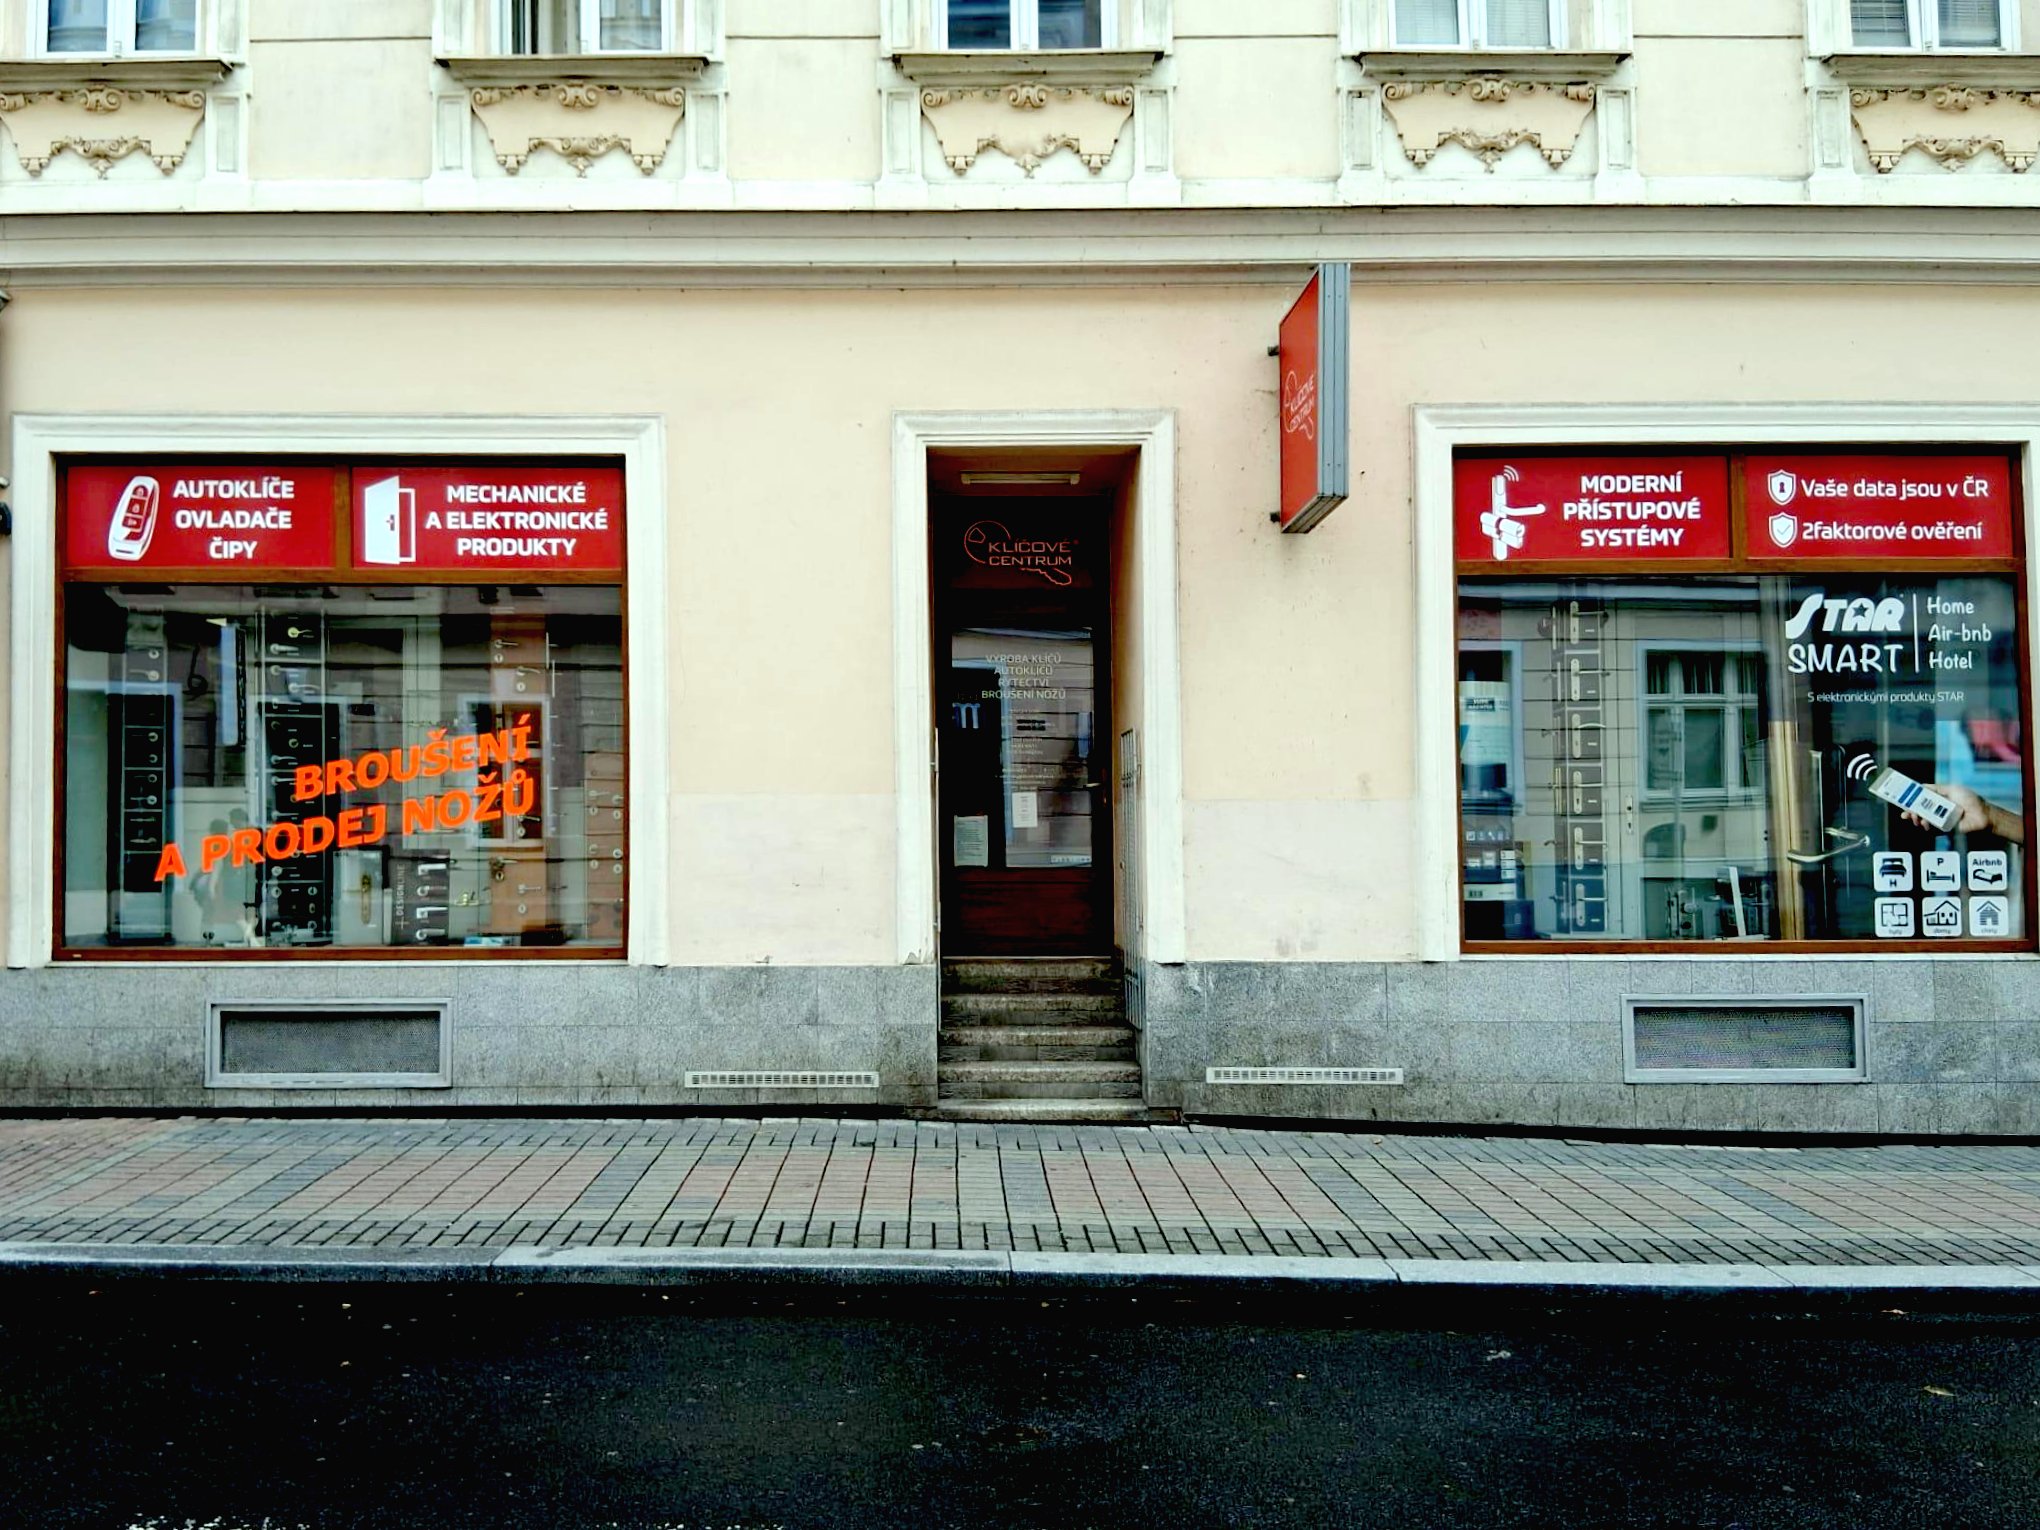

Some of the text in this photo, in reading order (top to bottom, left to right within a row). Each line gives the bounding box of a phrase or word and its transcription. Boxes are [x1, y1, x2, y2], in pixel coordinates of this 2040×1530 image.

[173, 476, 295, 499] AUTOKLÍČE
[447, 481, 586, 503] MECHANICKÉ
[1580, 470, 1683, 493] MODERNÍ
[1801, 475, 1989, 500] Vaše data jsou v ČR
[175, 506, 292, 529] OVLADAČE
[425, 508, 608, 530] A ELEKTRONICKÉ
[1563, 497, 1701, 520] PŘÍSTUPOVÉ
[1580, 524, 1684, 547] SYSTÉMY
[1802, 522, 1983, 540] 2faktorové ověření
[209, 536, 258, 559] ČIPY
[457, 538, 577, 556] PRODUKTY
[988, 538, 1072, 553] KLÍČOVÉ
[988, 555, 1072, 566] CENTRUM
[1785, 593, 1904, 639] STAR
[1927, 596, 1975, 615] Home
[1928, 623, 1993, 642] Air-bnb
[1787, 643, 1904, 673] SMART
[1928, 651, 1973, 670] Hotel
[981, 689, 1035, 700] BROUŠENÍ
[1807, 691, 1964, 704] S elektronickými produkty STAR
[294, 713, 532, 802] BROUŠENÍ
[154, 769, 535, 883] A PRODEJ NOŽŮ
[1936, 857, 1944, 866] P
[1972, 857, 2003, 867] Airbnb
[1889, 878, 1897, 888] H
